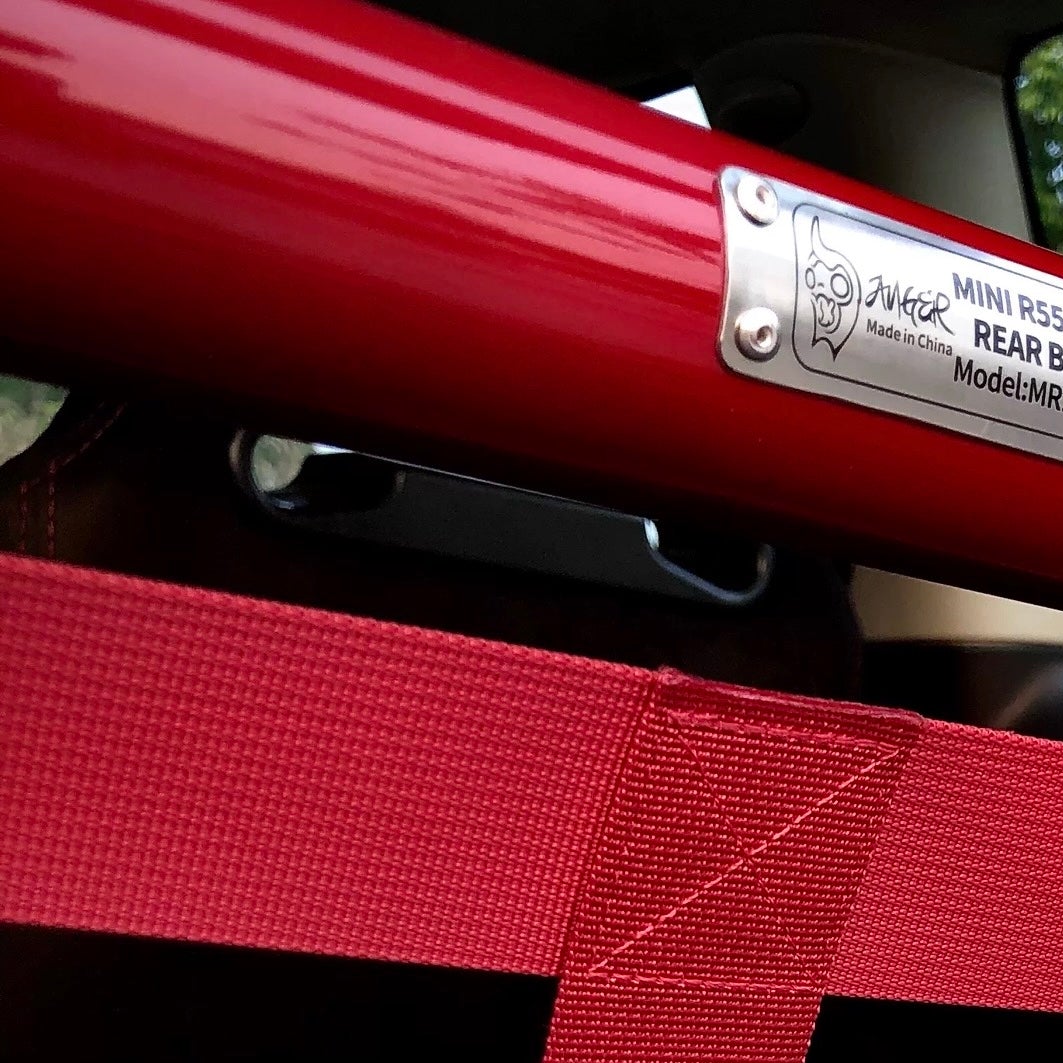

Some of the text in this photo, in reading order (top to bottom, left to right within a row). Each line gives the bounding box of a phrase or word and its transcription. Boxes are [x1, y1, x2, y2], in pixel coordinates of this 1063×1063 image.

[952, 272, 1013, 315] MINI
[866, 318, 953, 357] Made in China
[974, 319, 1043, 366] REAR
